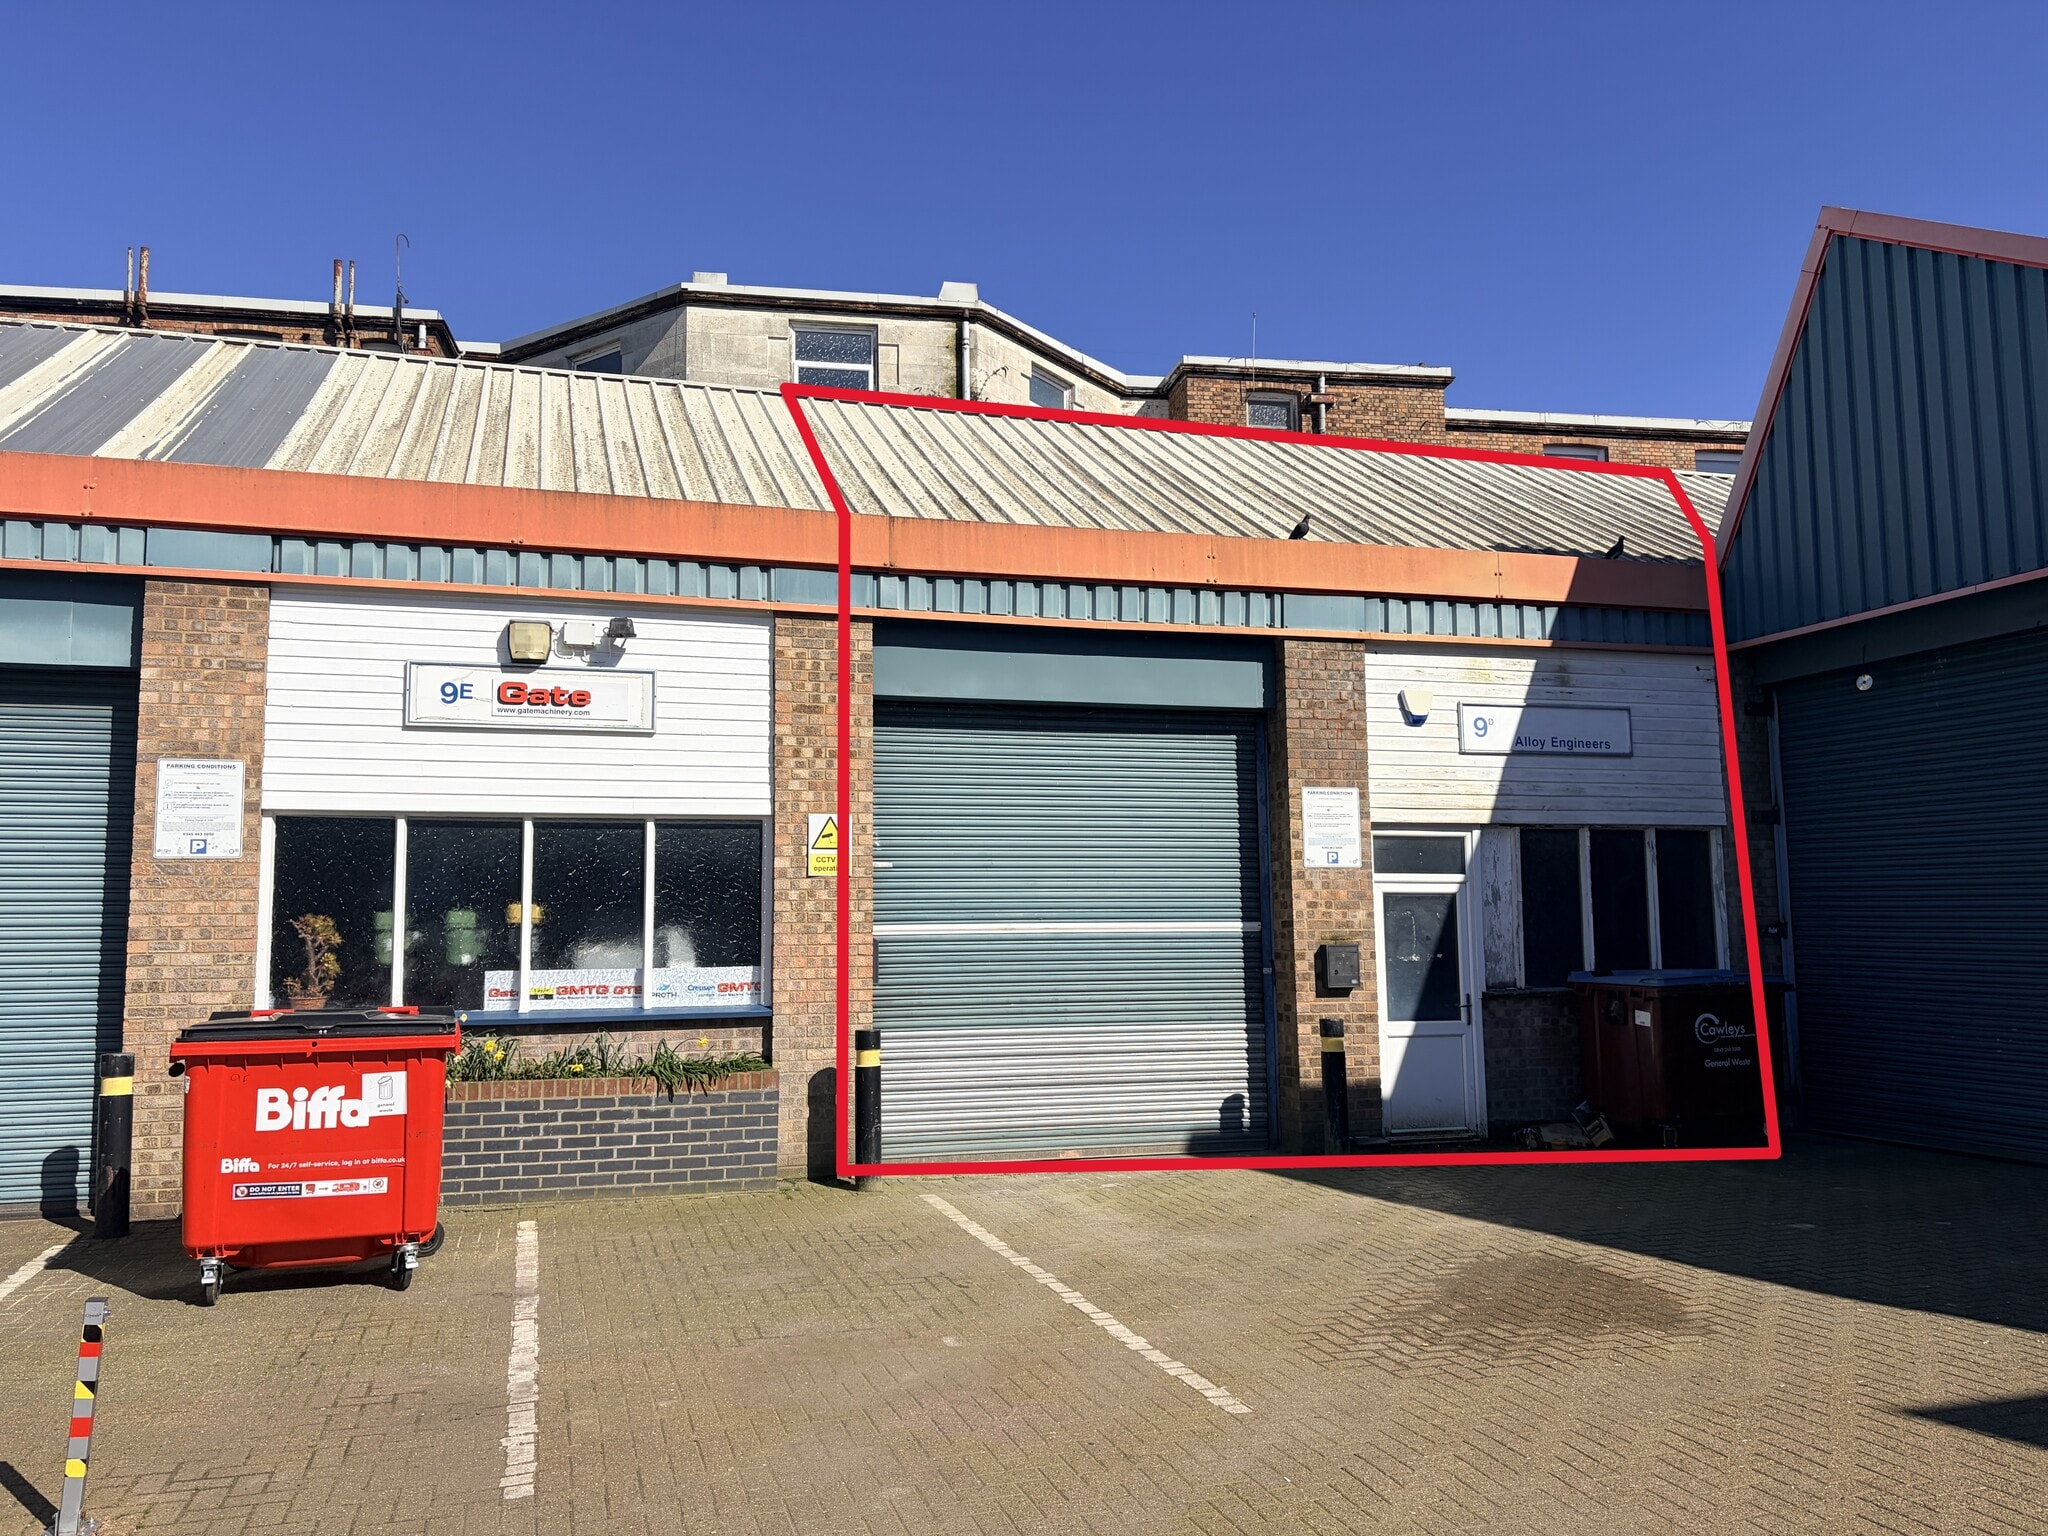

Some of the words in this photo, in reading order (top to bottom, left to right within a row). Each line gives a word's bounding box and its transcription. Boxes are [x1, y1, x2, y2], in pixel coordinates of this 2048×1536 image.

[440, 681, 474, 704] 9E
[497, 681, 592, 708] Gate
[497, 707, 590, 716] www.gatemachinery.com
[1514, 736, 1546, 750] Alloy
[1551, 736, 1611, 751] Engineers
[191, 839, 206, 854] P
[1327, 851, 1338, 864] P
[556, 985, 610, 995] GMTG
[1700, 1021, 1746, 1037] Cawleys
[1704, 1058, 1731, 1067] General
[1732, 1058, 1751, 1066] Waste
[255, 1085, 371, 1132] Biffa
[220, 1157, 261, 1174] Biffa
[280, 1161, 297, 1169] 24/7
[298, 1160, 341, 1168] self-service,
[341, 1159, 353, 1167] log
[371, 1156, 406, 1164] biffa.co.uk
